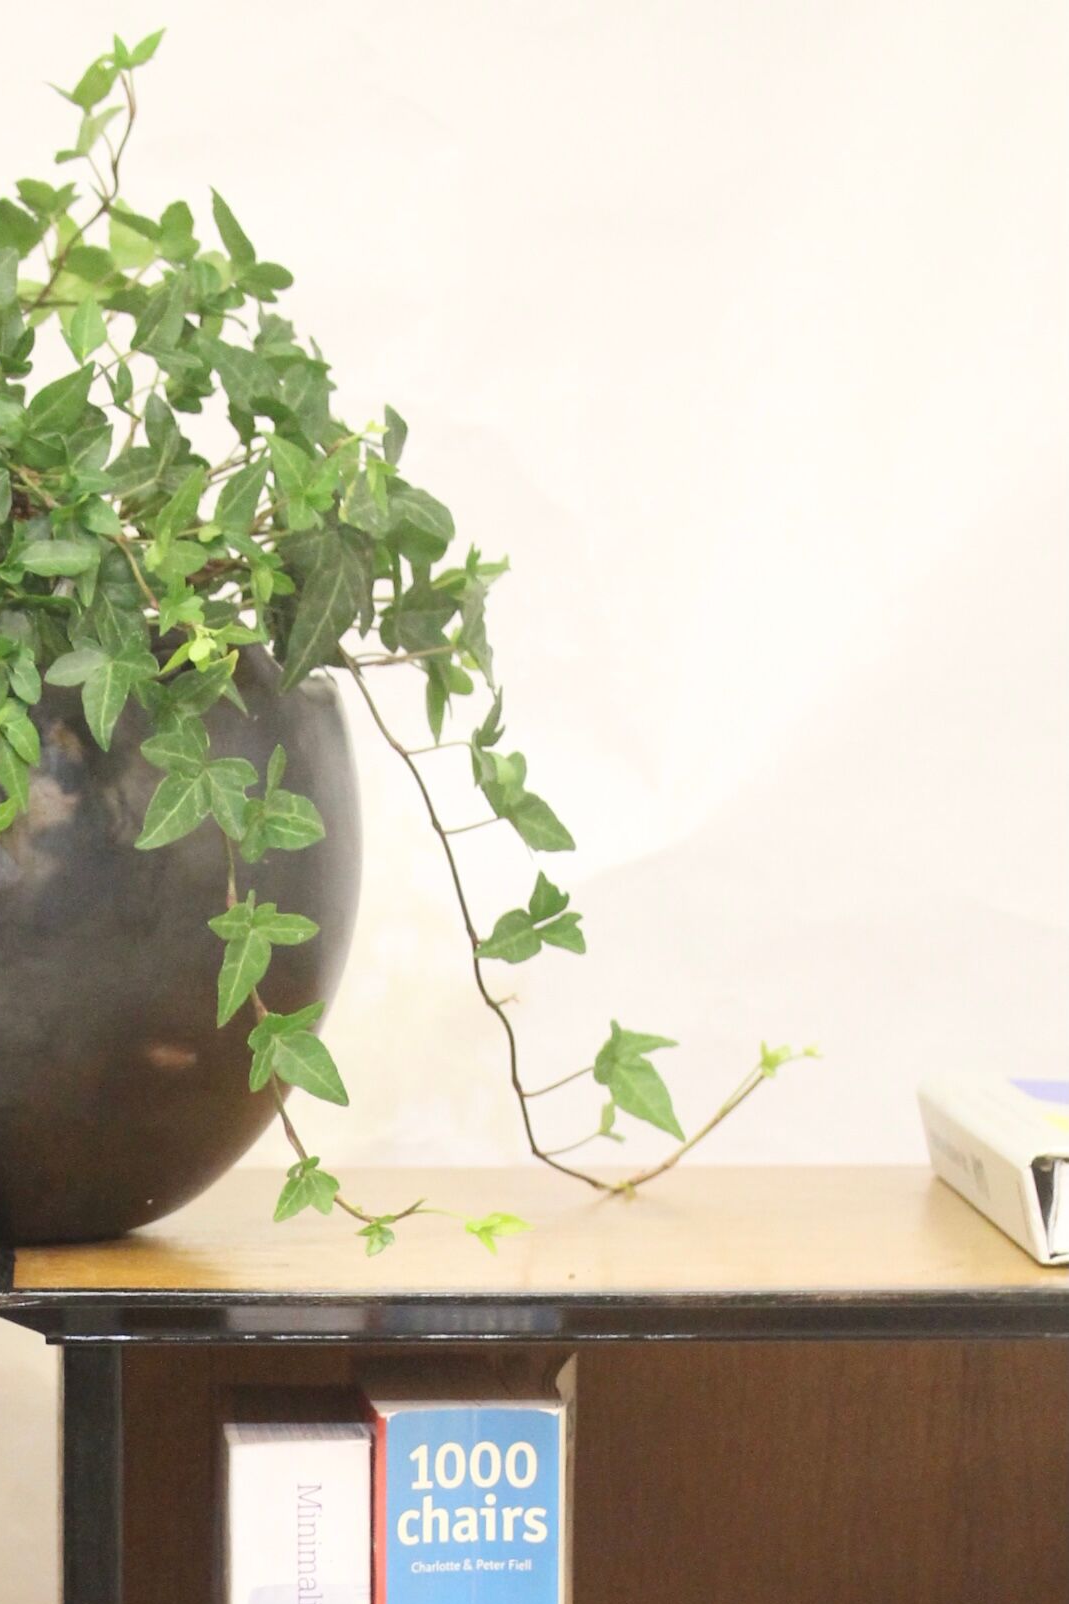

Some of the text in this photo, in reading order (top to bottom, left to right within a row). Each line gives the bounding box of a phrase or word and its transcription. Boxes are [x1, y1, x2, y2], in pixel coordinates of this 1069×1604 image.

[409, 1441, 538, 1490] 1000
[397, 1493, 548, 1546] chairs
[411, 1558, 532, 1574] Charlotte & Peter Fiell
